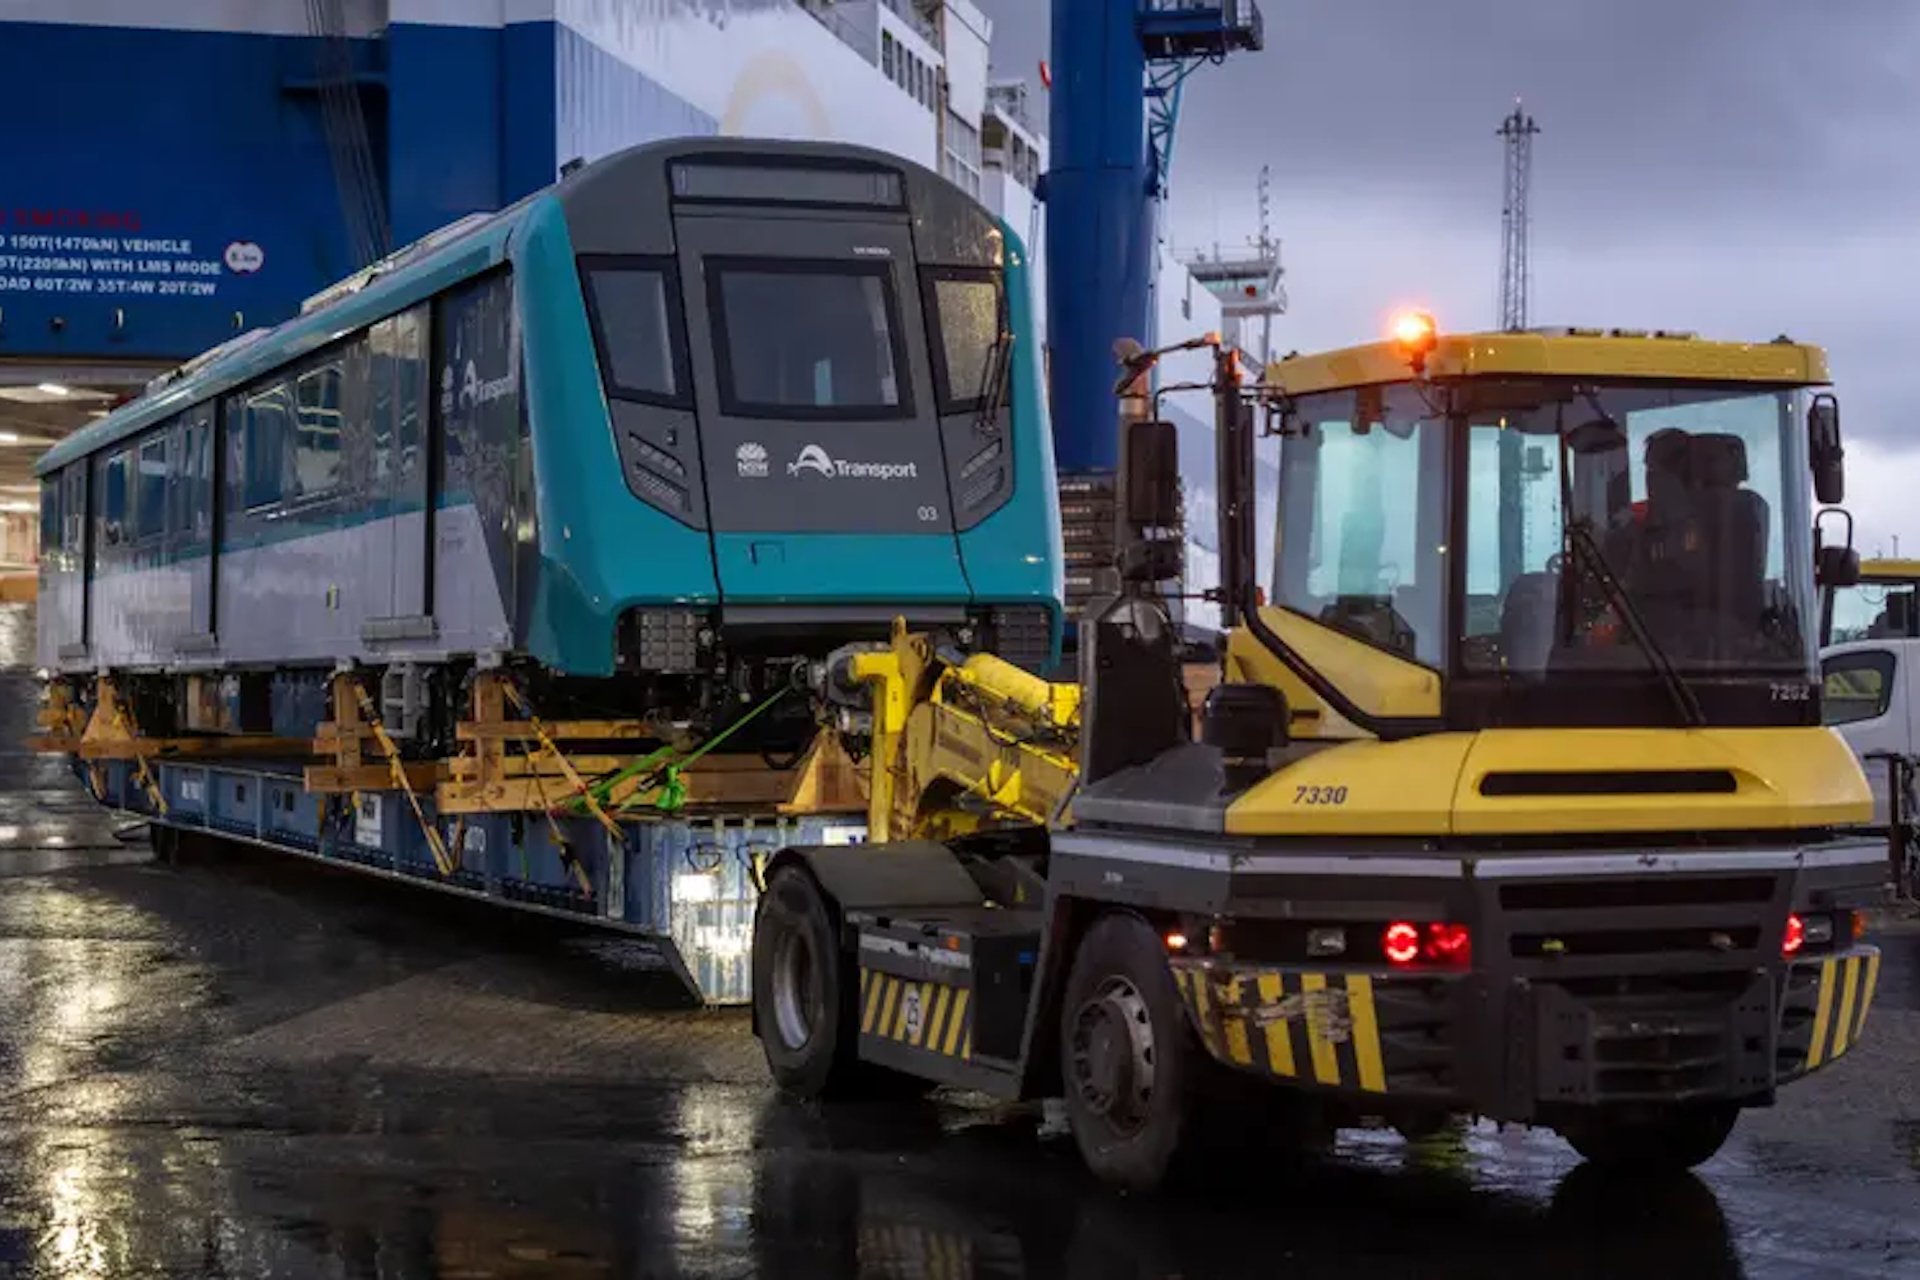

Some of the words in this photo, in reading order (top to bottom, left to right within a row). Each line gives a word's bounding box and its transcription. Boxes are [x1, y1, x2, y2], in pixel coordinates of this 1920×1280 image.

[122, 238, 192, 254] VEHICLE
[90, 258, 133, 273] WITH
[138, 259, 171, 273] LMS
[175, 261, 221, 275] MODE
[834, 460, 917, 480] Transport
[917, 506, 938, 521] 03
[1292, 785, 1348, 805] 7330
